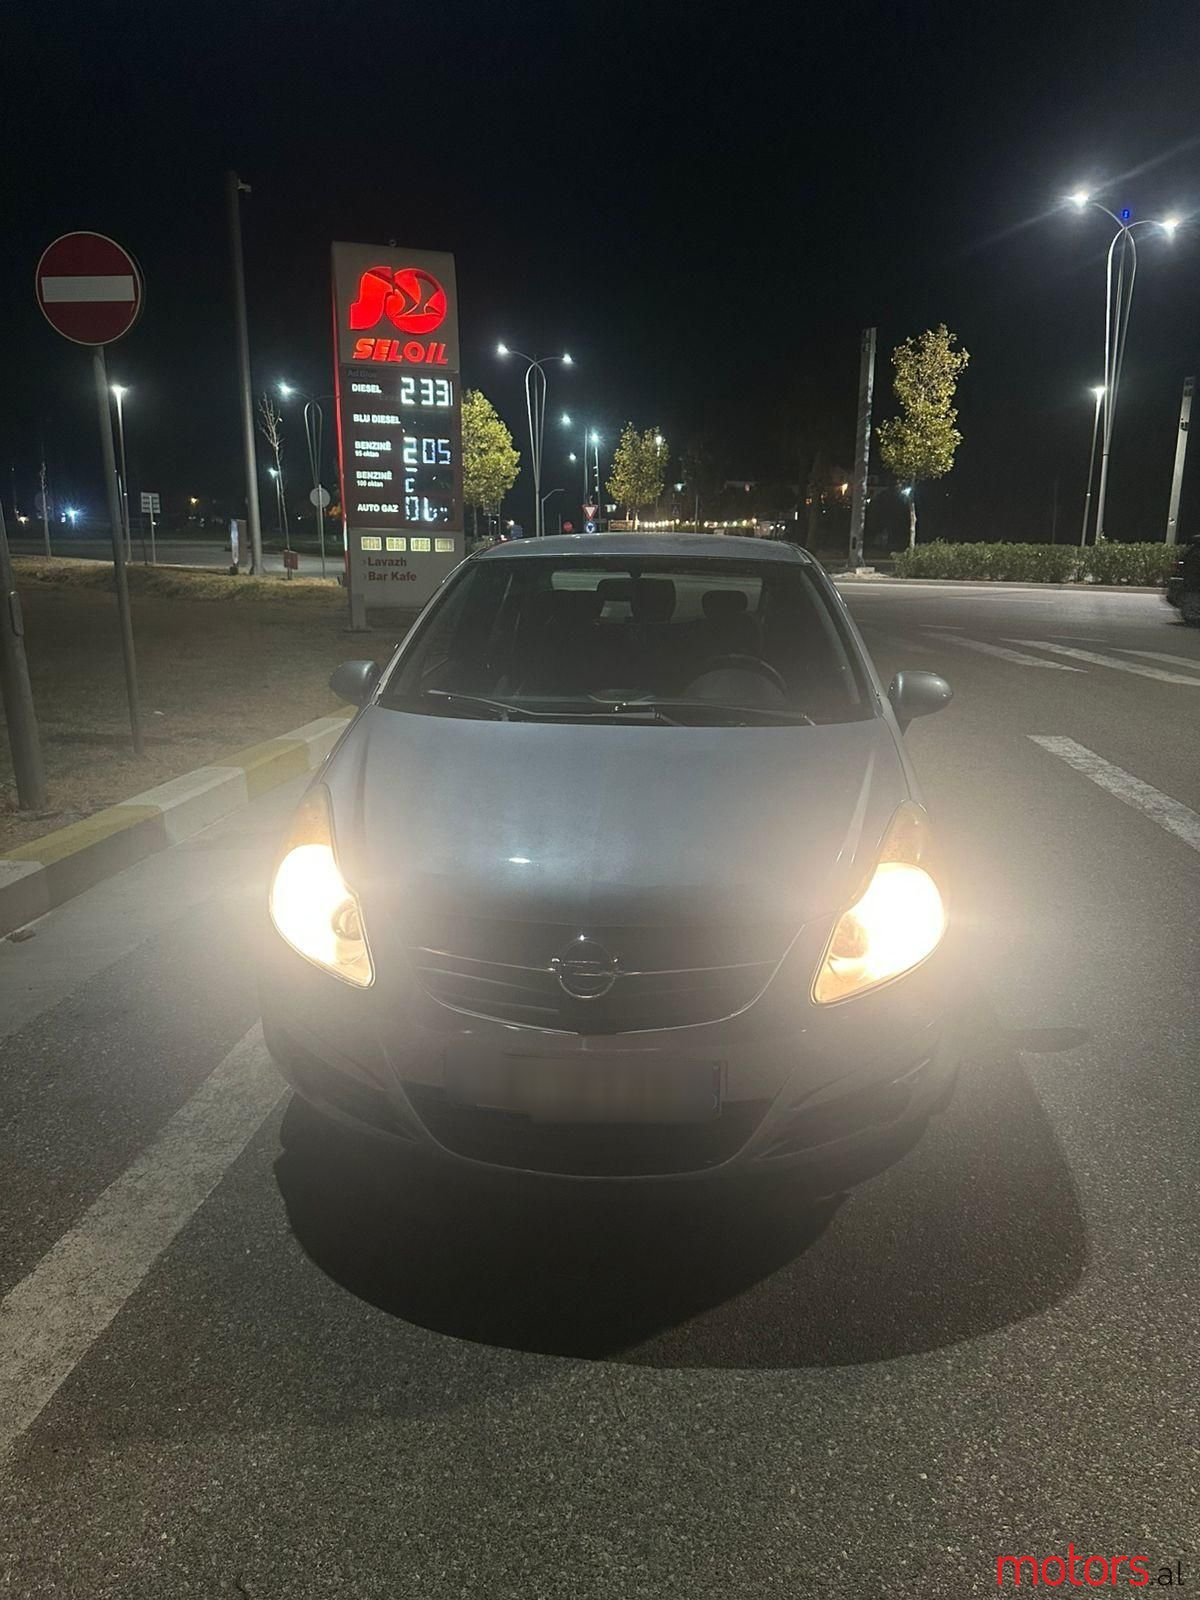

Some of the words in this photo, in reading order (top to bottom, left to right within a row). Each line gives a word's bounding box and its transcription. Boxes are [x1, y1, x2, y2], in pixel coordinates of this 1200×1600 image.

[353, 338, 448, 365] SELOIL
[352, 383, 382, 394] DIESEL
[401, 377, 450, 406] 233
[353, 414, 371, 423] BLU
[372, 415, 401, 425] DIESEL
[403, 437, 451, 464] 205
[357, 503, 380, 513] AUTO
[381, 504, 399, 513] GAZ
[367, 556, 407, 567] Lavazh
[368, 571, 388, 581] Bar
[391, 571, 417, 582] Kafe
